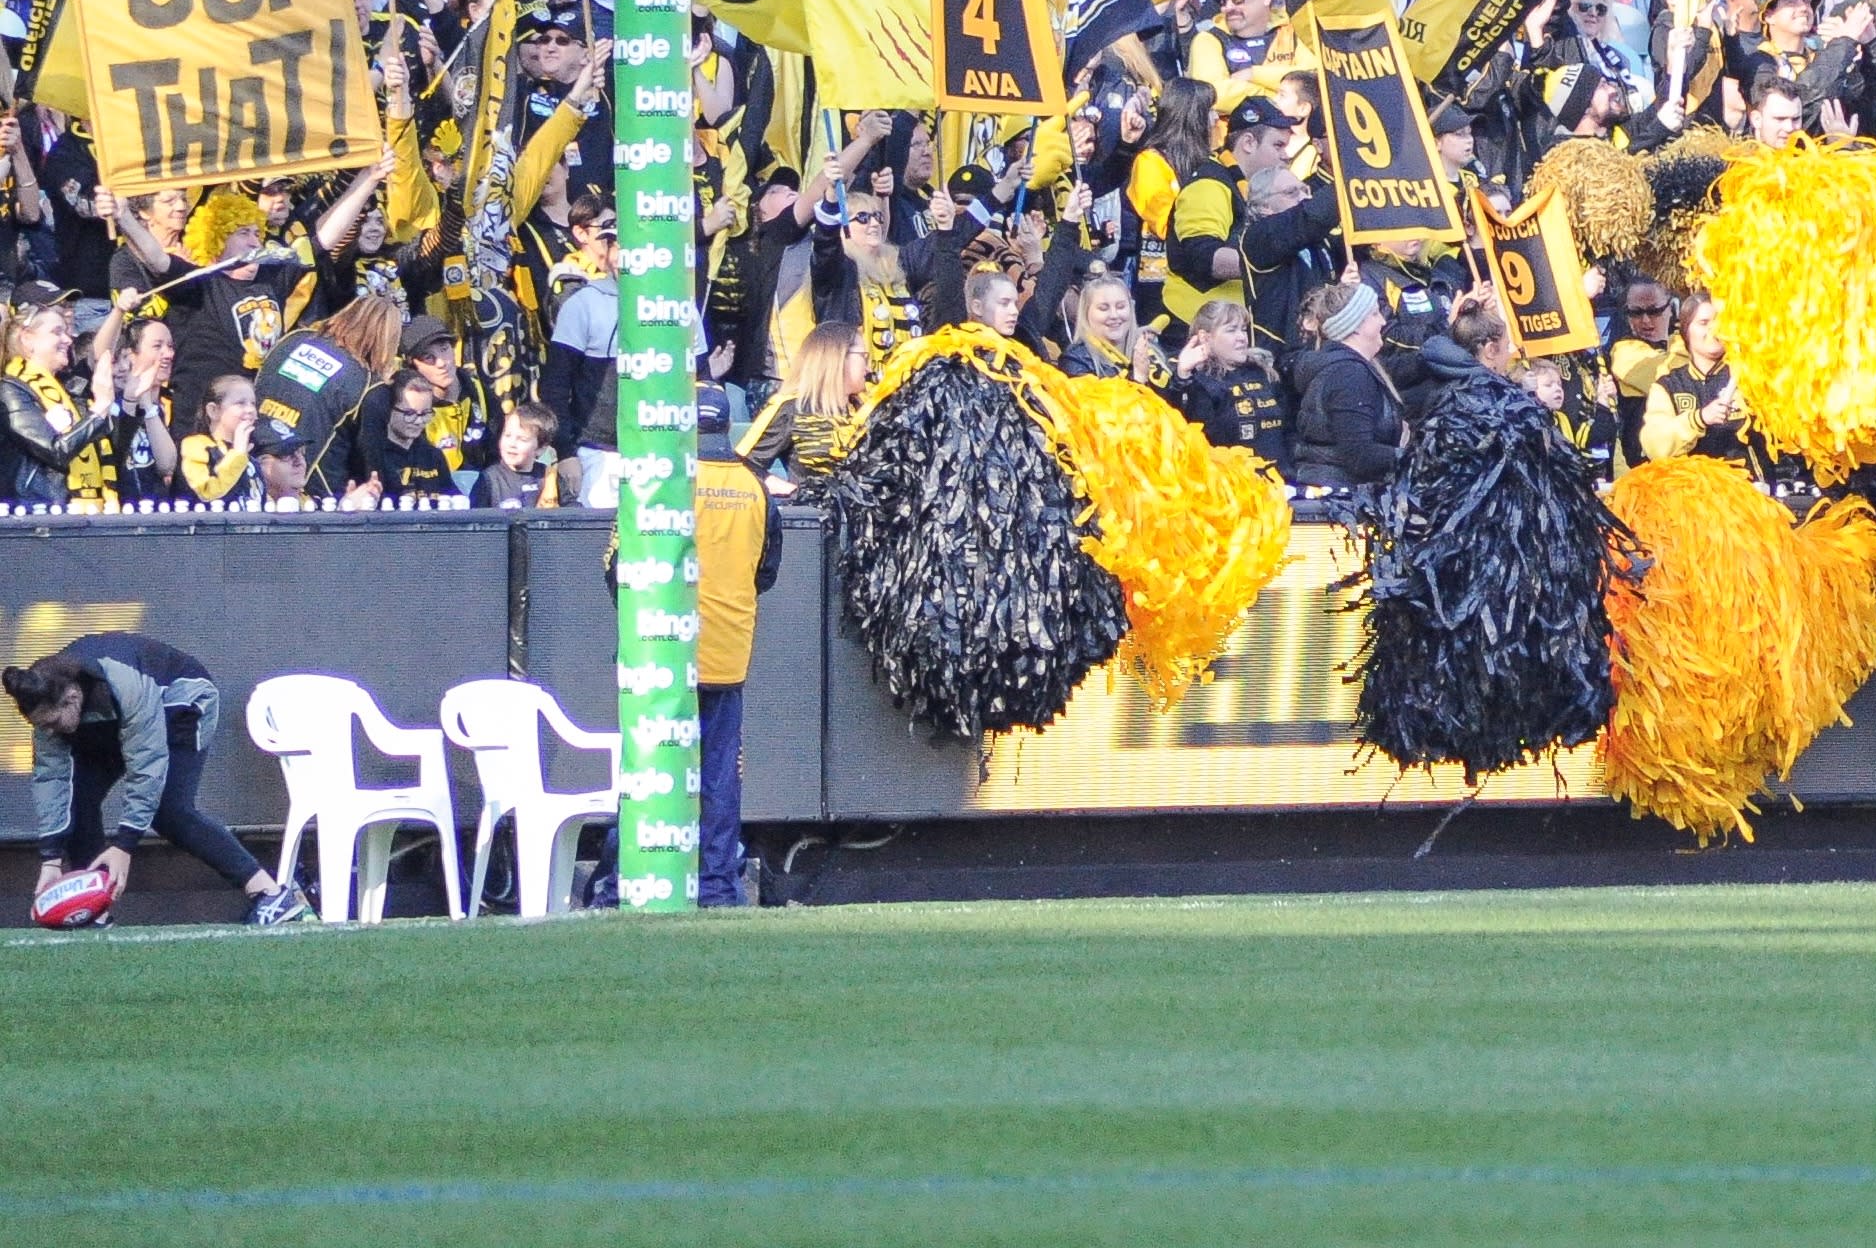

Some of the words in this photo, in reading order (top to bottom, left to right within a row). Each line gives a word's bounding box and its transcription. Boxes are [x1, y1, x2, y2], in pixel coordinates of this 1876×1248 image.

[108, 18, 350, 181] THAT!
[963, 68, 1023, 99] AVA
[1343, 90, 1394, 169] 9
[1348, 177, 1442, 210] COTCH
[1500, 250, 1536, 306] 9
[1518, 310, 1562, 334] TIGES
[297, 346, 334, 373] Jeep
[258, 398, 302, 428] OFFICIAL
